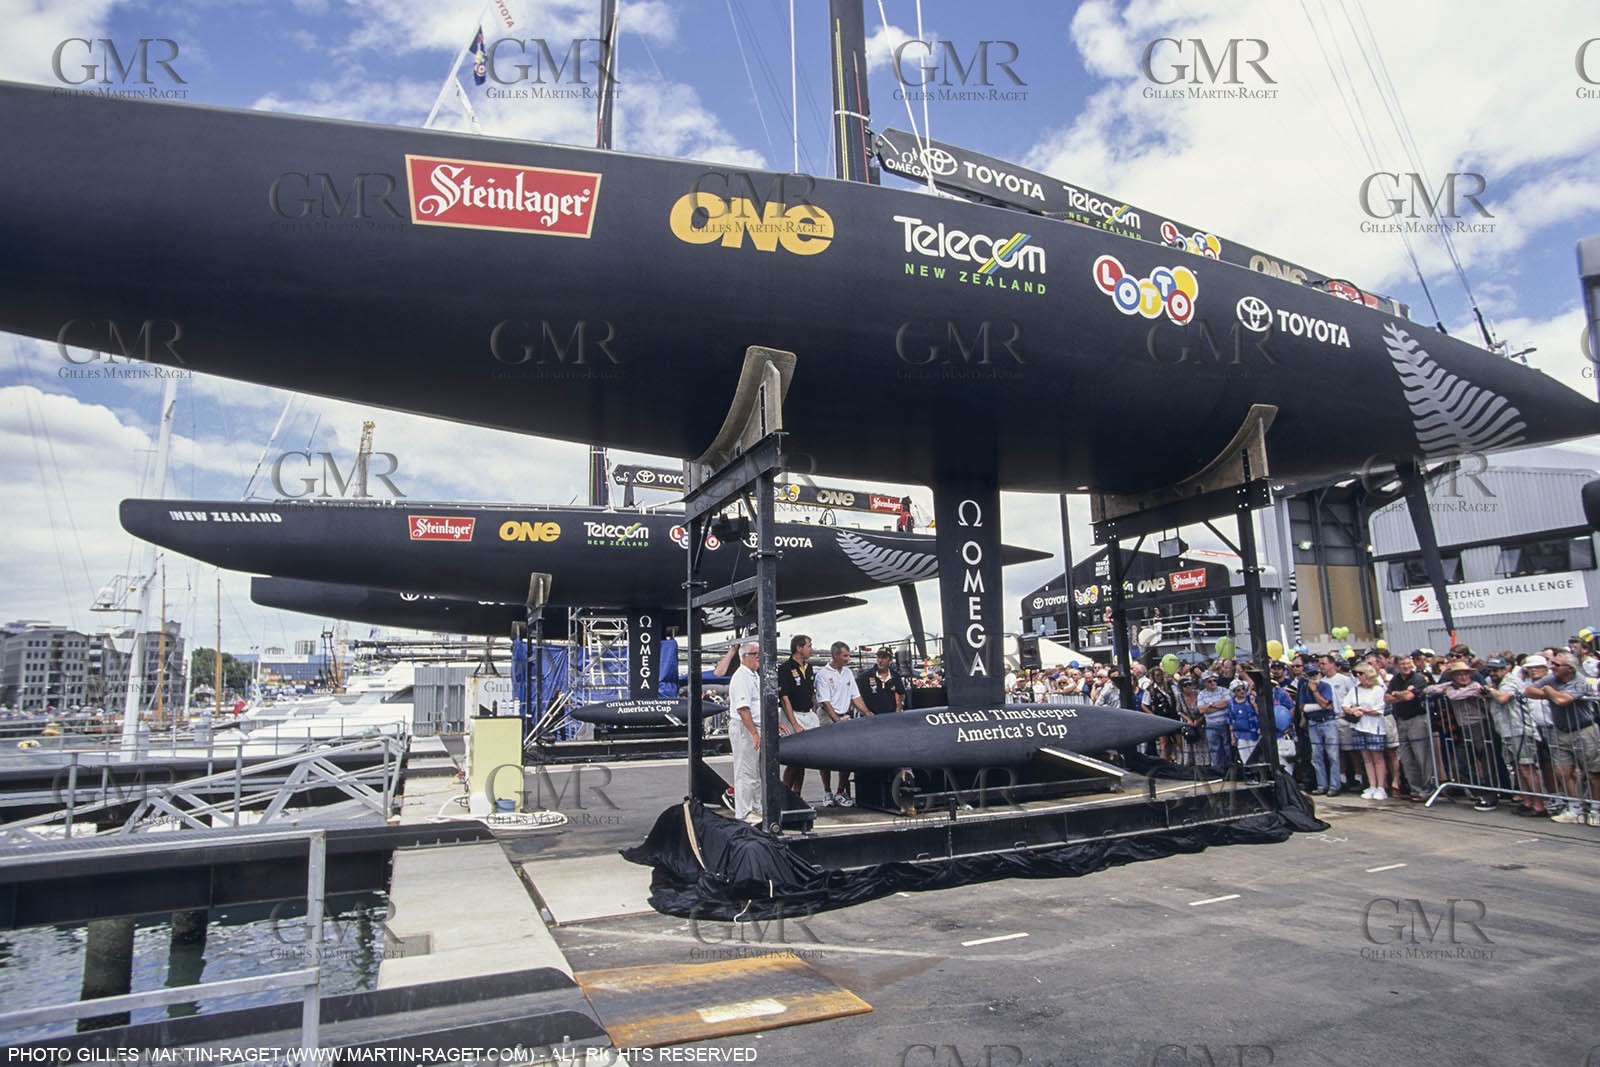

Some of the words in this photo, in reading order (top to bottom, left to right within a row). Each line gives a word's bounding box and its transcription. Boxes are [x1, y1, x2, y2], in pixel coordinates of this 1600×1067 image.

[885, 158, 929, 178] OMEGA
[963, 161, 1045, 201] TOYOTA
[419, 164, 590, 227] Steinlager
[1063, 185, 1141, 229] Telecom
[1068, 211, 1090, 224] NEW
[1096, 221, 1142, 240] ZEALAND
[893, 215, 1046, 275] Telecom
[905, 263, 946, 279] NEW
[959, 270, 1047, 295] ZEALAND
[1095, 257, 1195, 324] LOTTO
[1277, 309, 1351, 348] TOYOTA
[171, 511, 207, 521] NEW
[210, 512, 282, 523] ZEALAND
[412, 518, 472, 539] Steinlager
[583, 521, 649, 541] Telecom
[774, 536, 813, 549] OYOTA
[1447, 588, 1490, 600] ETCHER
[1497, 579, 1574, 595] CHALLENGE
[962, 540, 987, 677] OMEGA
[640, 633, 651, 689] OMEGA
[617, 705, 655, 714] America's
[656, 705, 672, 713] Cup
[925, 709, 989, 726] Official
[988, 707, 1078, 719] Timekeeper
[956, 722, 1034, 743] America's
[1037, 722, 1068, 738] Cup
